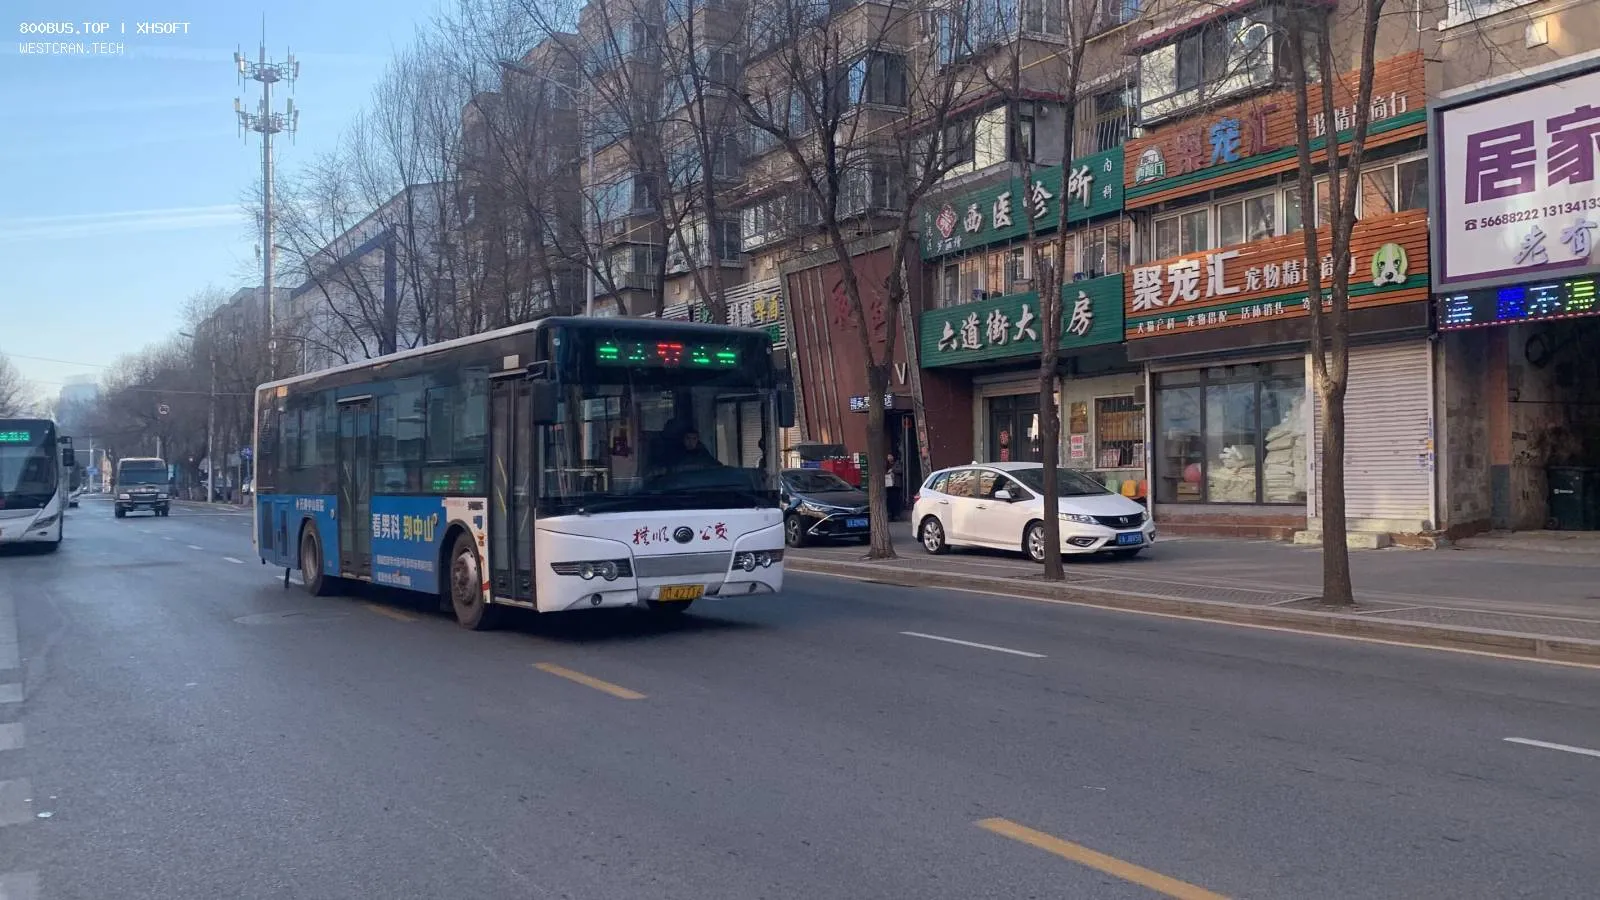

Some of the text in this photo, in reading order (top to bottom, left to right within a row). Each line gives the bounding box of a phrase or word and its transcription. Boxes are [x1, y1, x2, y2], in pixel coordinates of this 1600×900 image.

[1102, 157, 1113, 199] 内科
[1465, 104, 1600, 204] 居家
[963, 164, 1094, 233] 西医诊所
[1480, 209, 1538, 229] 56688222
[1132, 250, 1241, 312] 聚宠汇
[938, 290, 1094, 351] 六道街大房
[372, 513, 400, 540] 看男科
